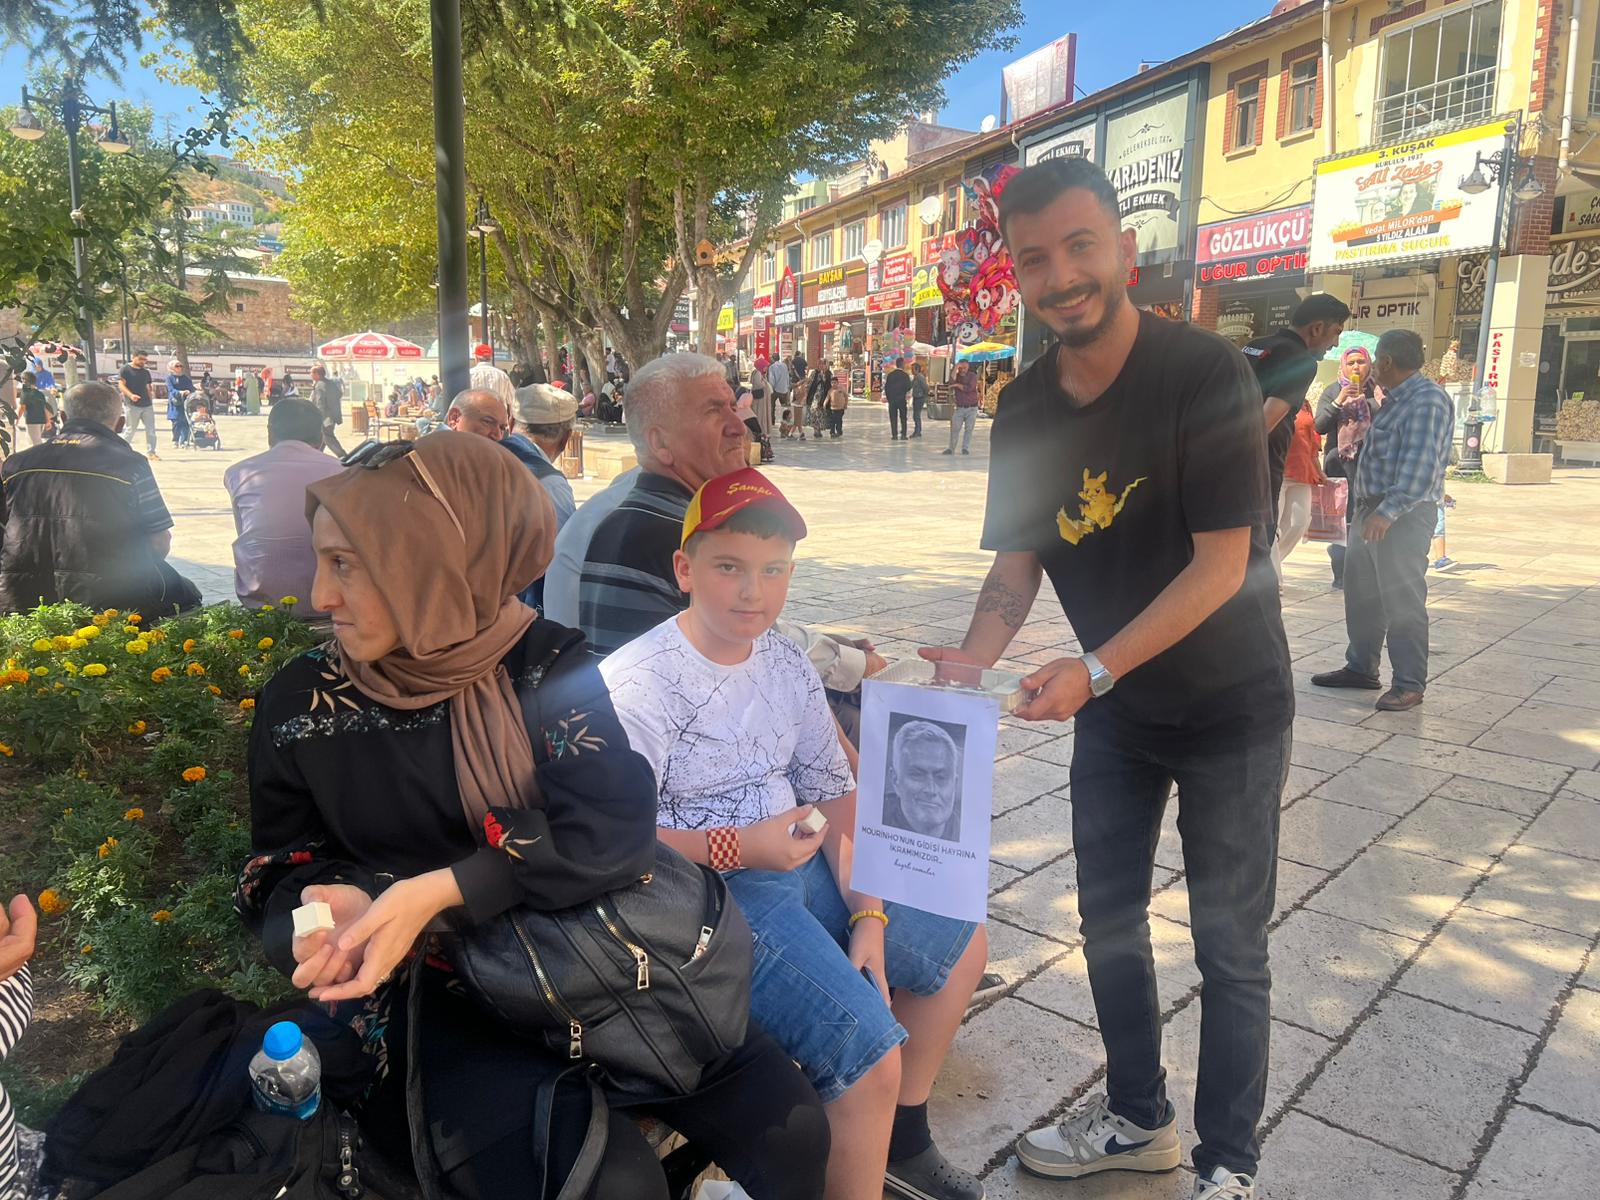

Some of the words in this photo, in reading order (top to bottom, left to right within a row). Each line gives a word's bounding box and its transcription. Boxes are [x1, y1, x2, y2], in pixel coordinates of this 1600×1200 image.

[1055, 144, 1081, 158] EKMEK
[1378, 150, 1389, 159] 3.
[1392, 139, 1435, 156] KUŞAK
[1392, 160, 1442, 184] Zade
[1119, 197, 1131, 215] TLİ
[1133, 193, 1167, 207] EKMEK
[1210, 212, 1305, 255] GÖZLÜKÇÜ
[1364, 224, 1386, 236] Vedat
[1405, 224, 1428, 238] ALAN
[1335, 241, 1398, 260] PASTIRMA
[1401, 235, 1450, 252] SUCUK
[1201, 261, 1247, 281] UĞUR
[1377, 301, 1421, 318] OPTİK
[1488, 332, 1503, 388] PASTIRM
